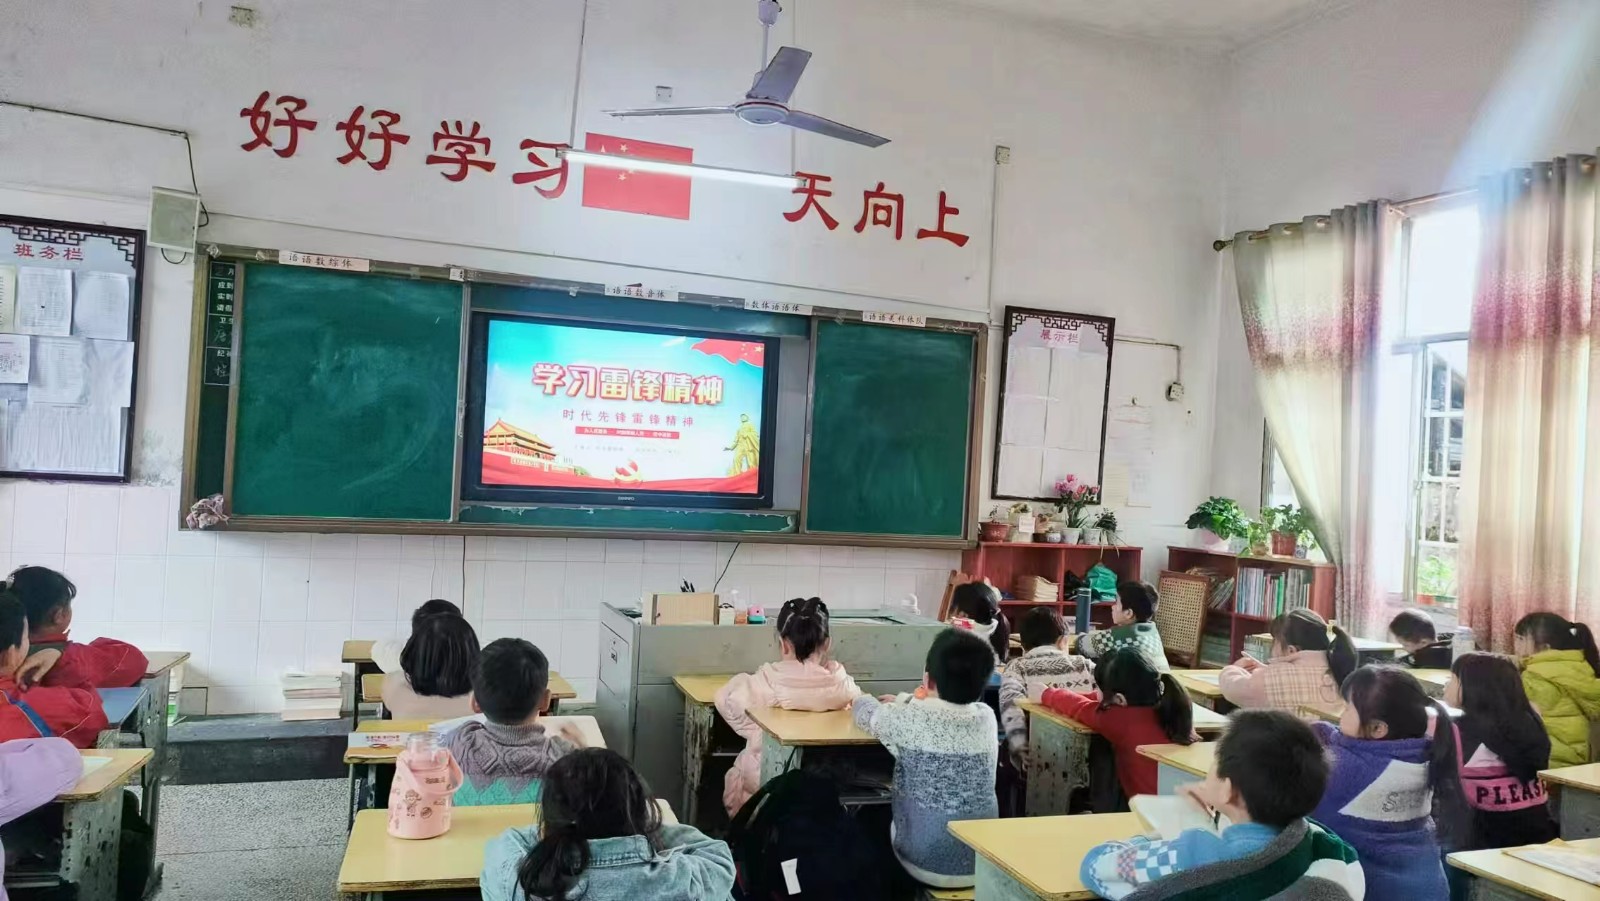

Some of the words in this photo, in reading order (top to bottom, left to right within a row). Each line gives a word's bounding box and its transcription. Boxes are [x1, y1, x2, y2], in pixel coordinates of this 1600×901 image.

[240, 90, 569, 199] 好好学习
[783, 171, 970, 247] 天向上
[14, 243, 84, 261] 班务栏
[1040, 329, 1079, 344] 展示栏
[532, 362, 724, 406] 学习雷锋精神
[562, 408, 694, 428] 时代先锋雷锋精神
